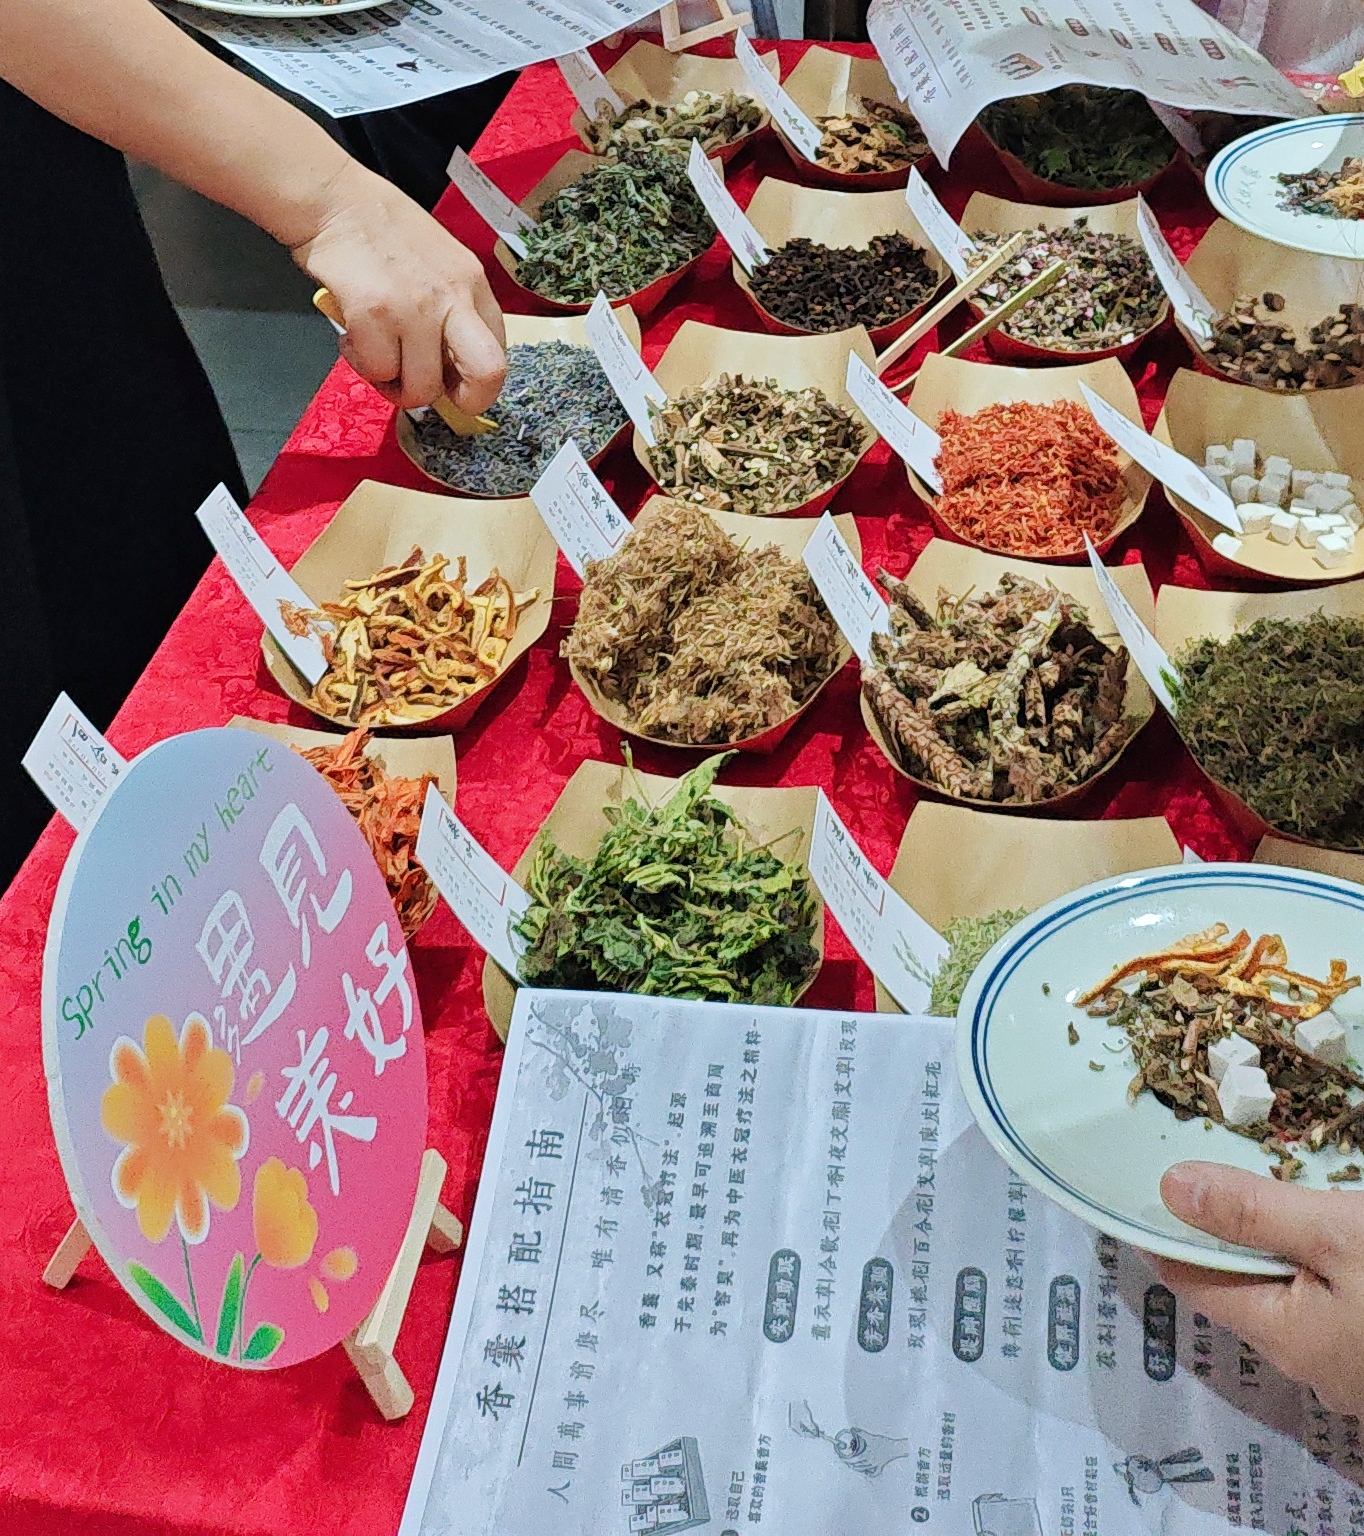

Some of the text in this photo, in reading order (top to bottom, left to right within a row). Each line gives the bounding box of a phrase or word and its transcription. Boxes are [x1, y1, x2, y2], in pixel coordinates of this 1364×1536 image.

[61, 746, 275, 1041] Spring in my heart
[275, 920, 413, 1196] 美好
[476, 1128, 565, 1421] 香囊搭配指南
